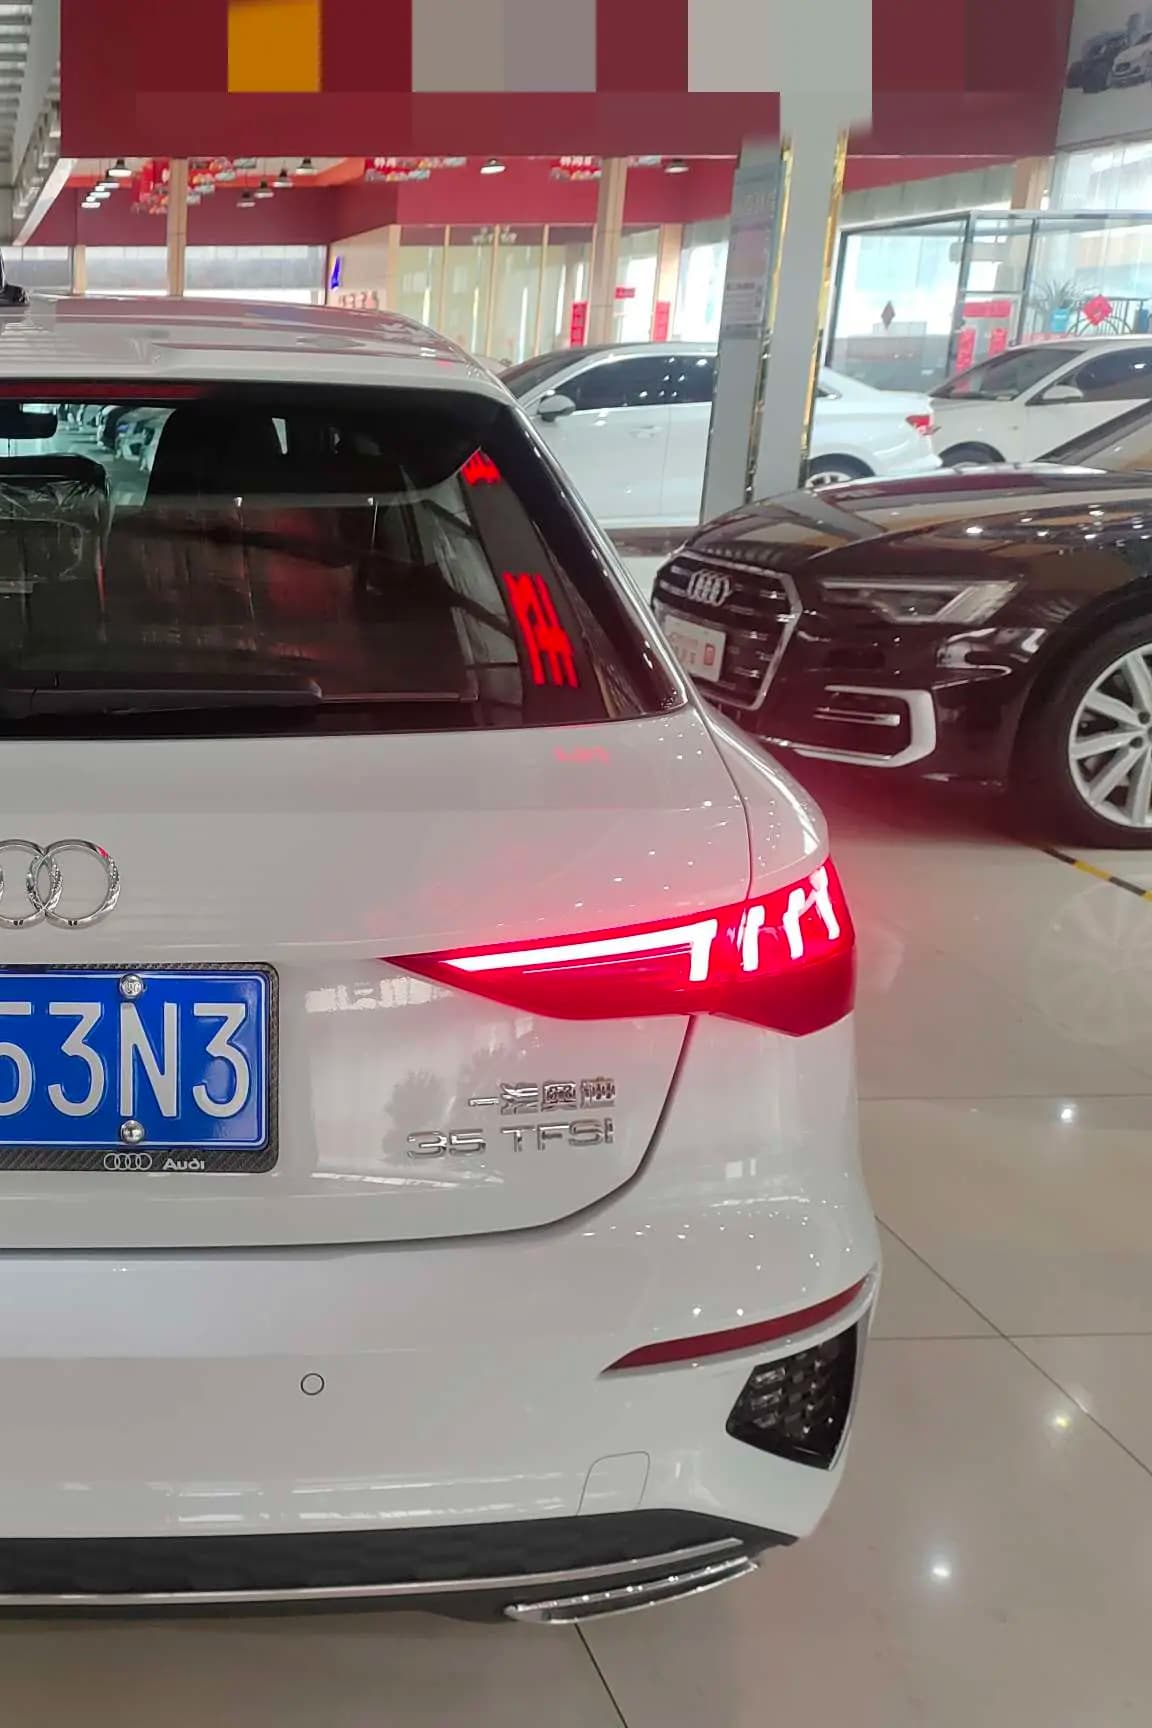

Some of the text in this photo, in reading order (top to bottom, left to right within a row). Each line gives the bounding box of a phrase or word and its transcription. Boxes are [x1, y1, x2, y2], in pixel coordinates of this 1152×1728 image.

[406, 1117, 615, 1159] 35 TFSI
[163, 1158, 206, 1171] Audi
